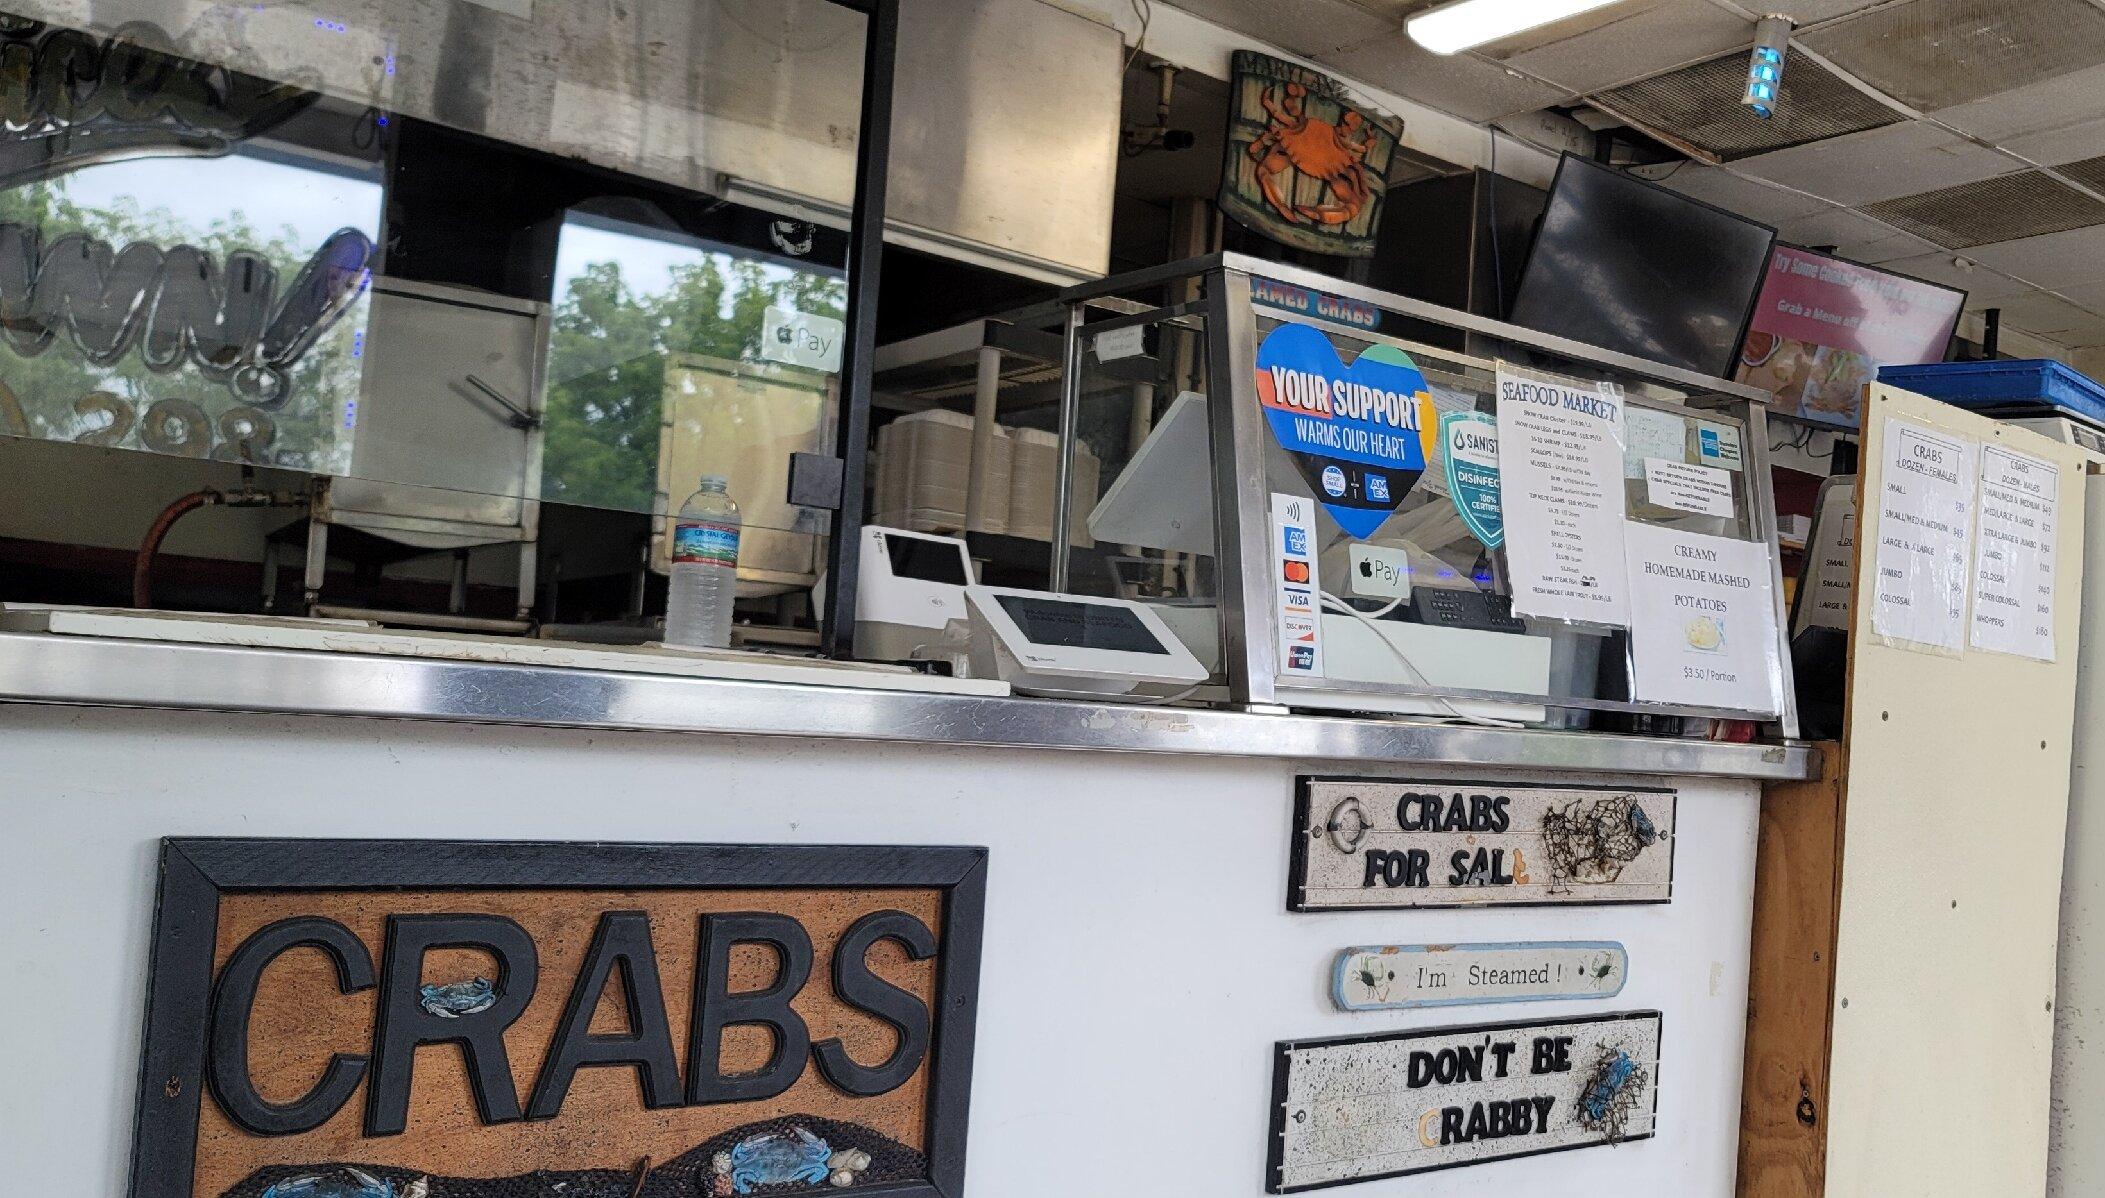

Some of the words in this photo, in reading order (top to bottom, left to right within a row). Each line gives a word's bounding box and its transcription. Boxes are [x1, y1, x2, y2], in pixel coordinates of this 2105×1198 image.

[1250, 280, 1308, 310] AMED
[1317, 294, 1375, 327] CRABS
[1777, 299, 1802, 316] Grab
[797, 326, 832, 358] Pay
[1271, 366, 1330, 414] YOUR
[1333, 379, 1422, 432] SUPPORT
[1502, 382, 1559, 406] SEAFOOD
[1563, 390, 1617, 422] MARKET
[1295, 418, 1341, 449] WARMS
[1343, 427, 1369, 454] OUR
[1371, 435, 1405, 461] HEART
[1914, 444, 1942, 464] CRABS
[1902, 459, 1925, 472] DOZEN
[1929, 466, 1956, 482] FEMALES
[2010, 460, 2029, 474] CRABS
[1887, 483, 1906, 494] SMALL
[2002, 475, 2020, 486] DOZEN
[1479, 494, 1497, 504] 100%
[1925, 519, 1948, 532] MEDIUM
[1290, 532, 1305, 542] AM
[1882, 536, 1902, 548] LARGE
[2020, 539, 2036, 549] JUMBO
[1293, 542, 1306, 552] EX
[1674, 544, 1717, 562] CREAMY
[1984, 550, 2002, 560] JUMBO
[1826, 559, 1848, 567] SMALL
[1376, 560, 1400, 586] Pay
[1644, 562, 1706, 582] HOMEMADE
[1708, 572, 1750, 588] MASHED
[1881, 567, 1902, 579] JUMBO
[1980, 570, 2005, 583] COLOSSAL
[1288, 594, 1309, 606] VISA
[1674, 594, 1727, 612] POTATOES
[1880, 593, 1911, 606] COLOSSAL
[1979, 591, 1994, 602] SUPER
[1818, 601, 1839, 610] LARGE
[1976, 614, 2004, 627] WHOPPERS
[1684, 666, 1703, 680] $3.50
[1711, 668, 1737, 682] Portion
[1396, 792, 1510, 833] CRABS
[1364, 848, 1430, 888] FOR
[1417, 966, 1447, 989] I'm
[205, 909, 938, 1138] CRABS
[1407, 1035, 1515, 1088] DON'T
[1531, 1036, 1573, 1075] BE
[1418, 1096, 1556, 1148] CRABBY
